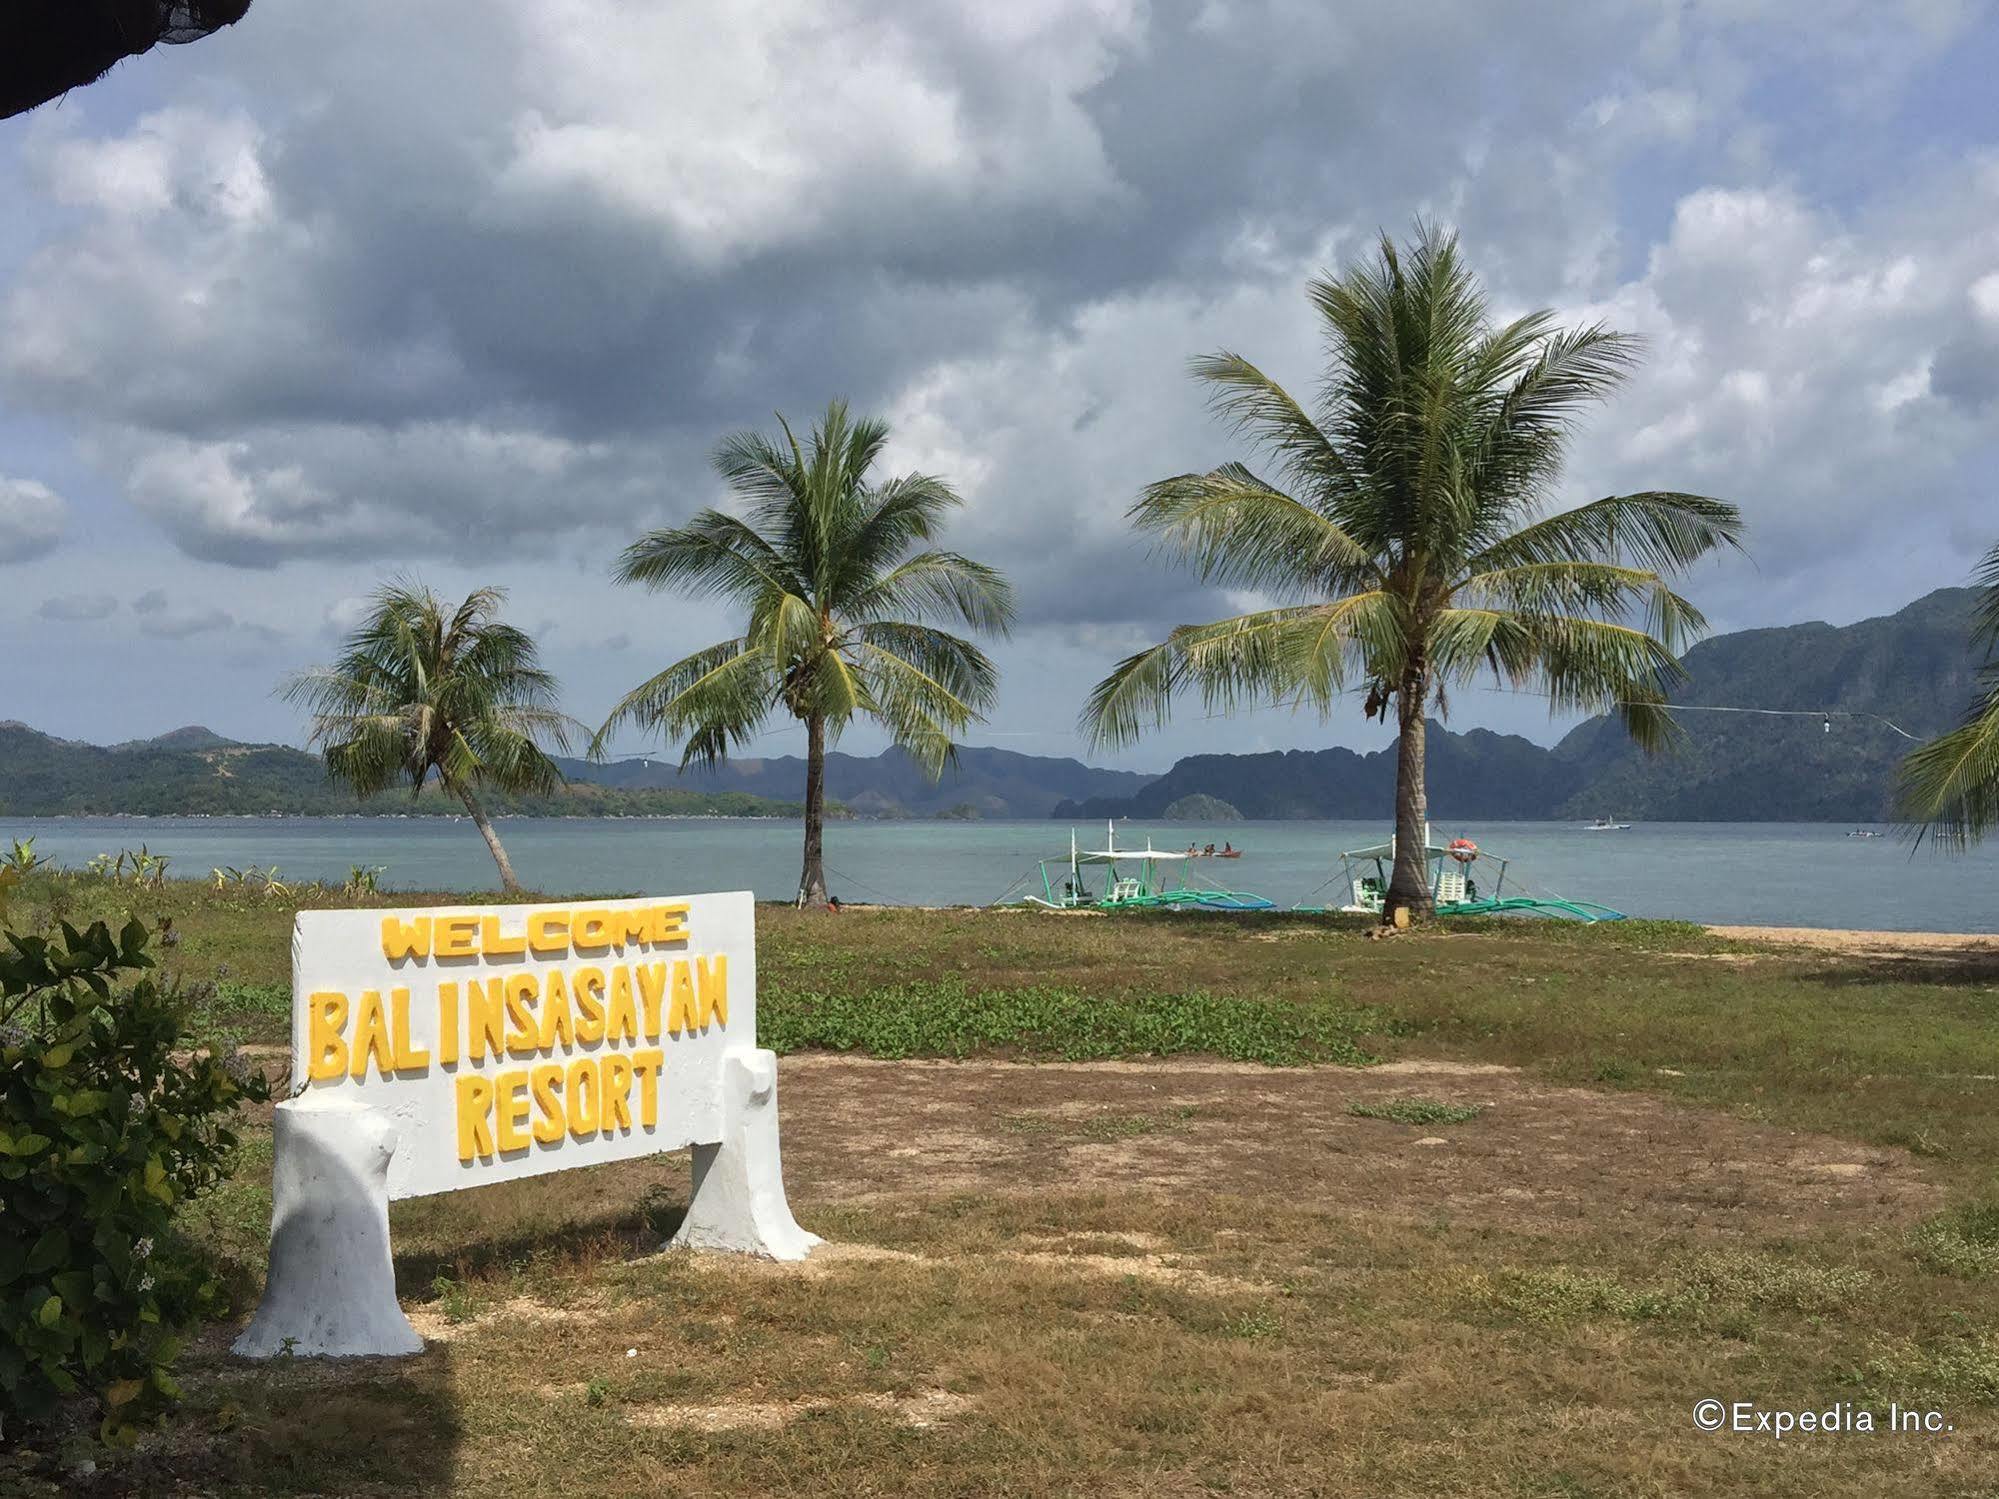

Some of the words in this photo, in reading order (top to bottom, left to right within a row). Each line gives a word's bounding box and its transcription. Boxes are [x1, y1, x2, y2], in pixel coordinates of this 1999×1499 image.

[381, 903, 690, 960] WELCOME
[307, 953, 728, 1081] BALINSASAYAN
[455, 1049, 664, 1162] RESORT
